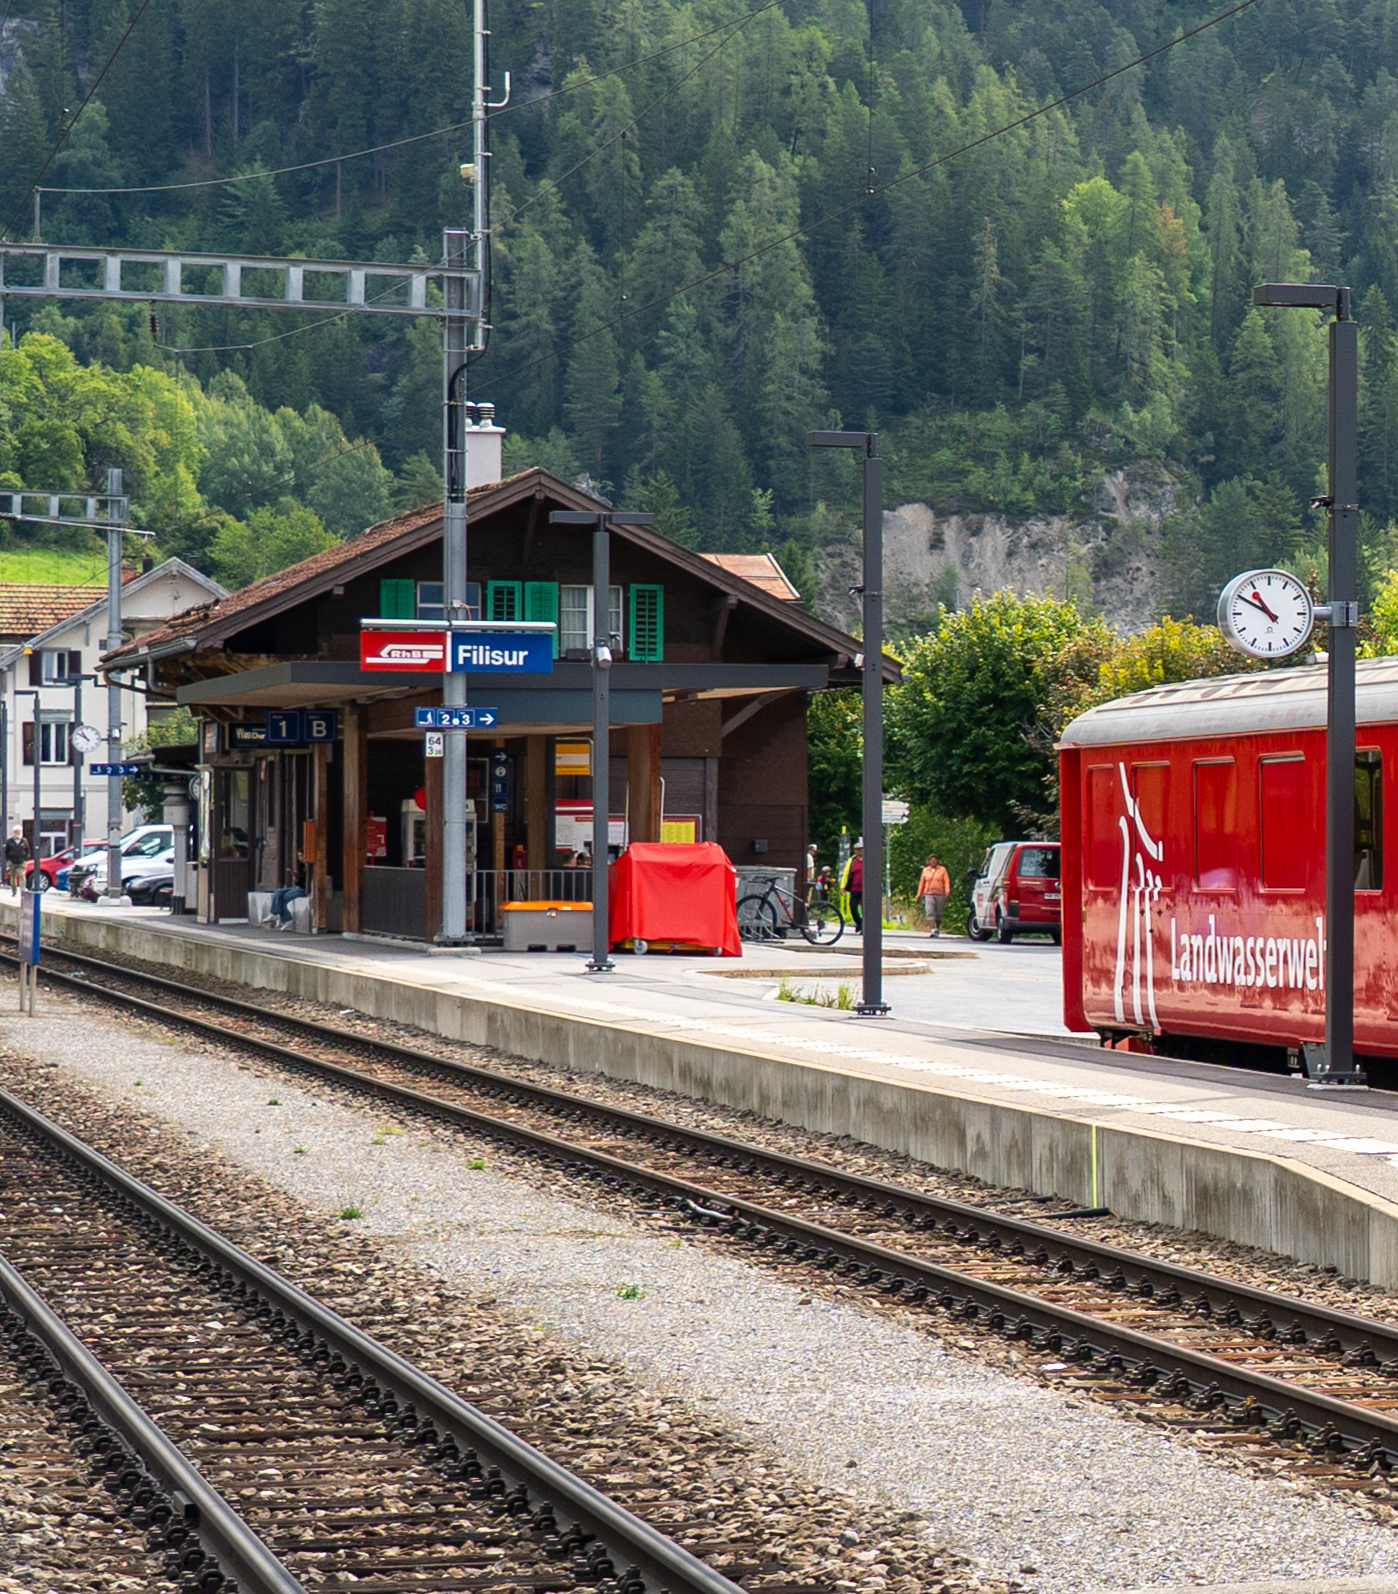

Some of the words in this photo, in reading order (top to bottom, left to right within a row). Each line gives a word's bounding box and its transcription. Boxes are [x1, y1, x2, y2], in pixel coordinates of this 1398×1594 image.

[390, 650, 422, 658] RhB
[458, 645, 529, 666] Filisur
[441, 714, 450, 724] 2
[462, 714, 470, 724] 3
[279, 720, 287, 737] 1
[312, 720, 327, 737] B
[428, 736, 442, 746] 64
[1171, 914, 1327, 990] Landwasserwel
